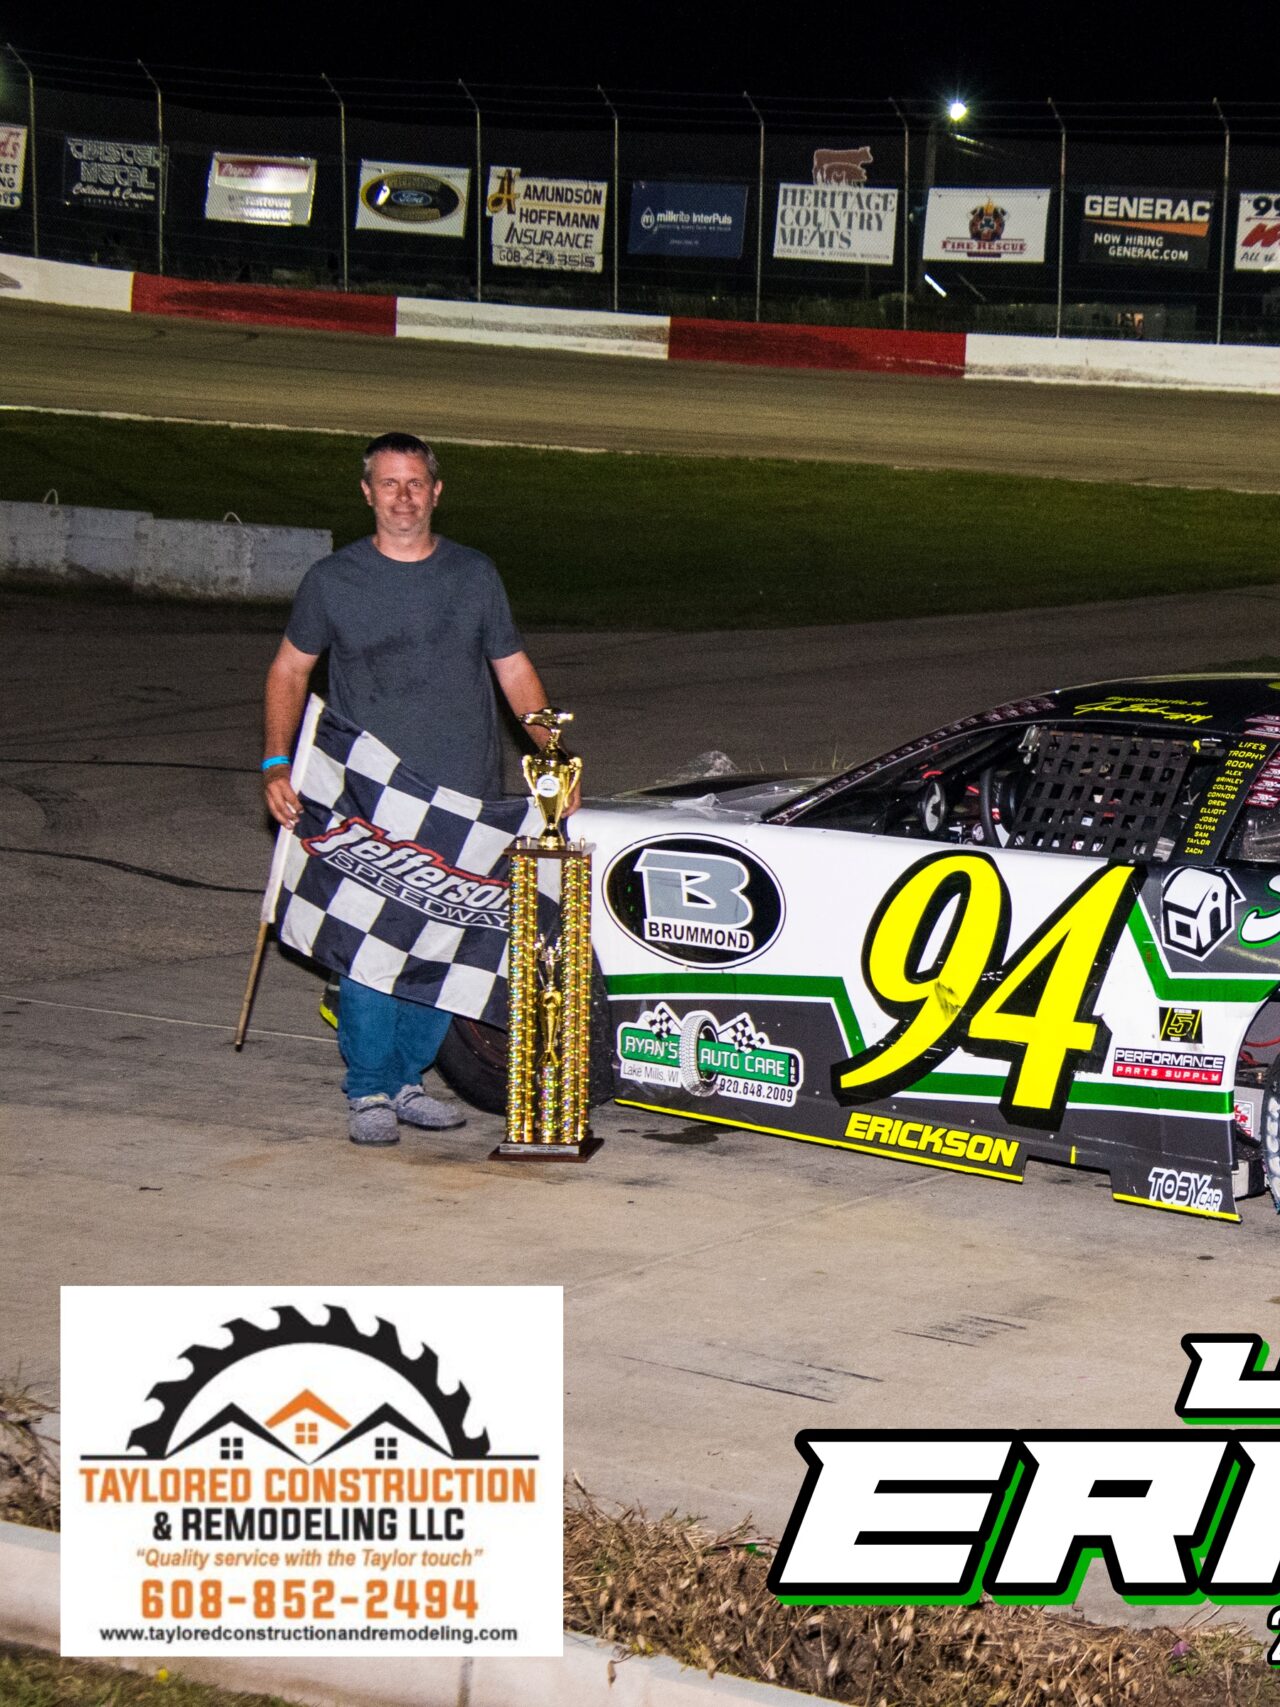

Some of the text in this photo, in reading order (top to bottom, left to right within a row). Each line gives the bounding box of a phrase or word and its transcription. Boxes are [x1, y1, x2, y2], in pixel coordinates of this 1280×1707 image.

[81, 161, 155, 190] METAL
[523, 184, 603, 206] AMUNDSON
[782, 188, 896, 212] HERITAGE
[1084, 195, 1213, 223] GENERAC
[519, 207, 600, 230] HOFFMANN
[780, 207, 888, 231] COUNTRY
[780, 222, 852, 249] MEATS
[1094, 233, 1163, 247] NOW HIRING
[1108, 246, 1189, 261] GENERAC.COM
[1238, 741, 1267, 751] LIFE'S
[1228, 750, 1266, 761] TROPHY
[1225, 760, 1254, 770] ROOM
[1212, 784, 1238, 792] COLTON
[1216, 776, 1244, 785] BRINLEY
[1207, 791, 1236, 800] CONNOR
[1207, 799, 1227, 807] DREW
[1199, 816, 1218, 824] JOSH
[1200, 807, 1227, 816] ELLIOTT
[1194, 823, 1216, 832] OLIVIA
[1184, 847, 1204, 855] ZACH
[1186, 838, 1211, 846] TAYLOR
[334, 854, 511, 928] SPEEDWAY
[650, 921, 750, 949] BRUMMOND
[836, 851, 1142, 1120] 94
[625, 1035, 679, 1059] RYAN'S
[700, 1048, 740, 1070] AUTO
[744, 1055, 786, 1077] CARE
[1115, 1049, 1224, 1069] PERFORMANCE
[623, 1063, 679, 1083] Lake Mills, WI
[1116, 1065, 1219, 1081] PARTS SUPPLY
[719, 1078, 793, 1103] 920.648.2009
[844, 1112, 1020, 1168] ERICKSON
